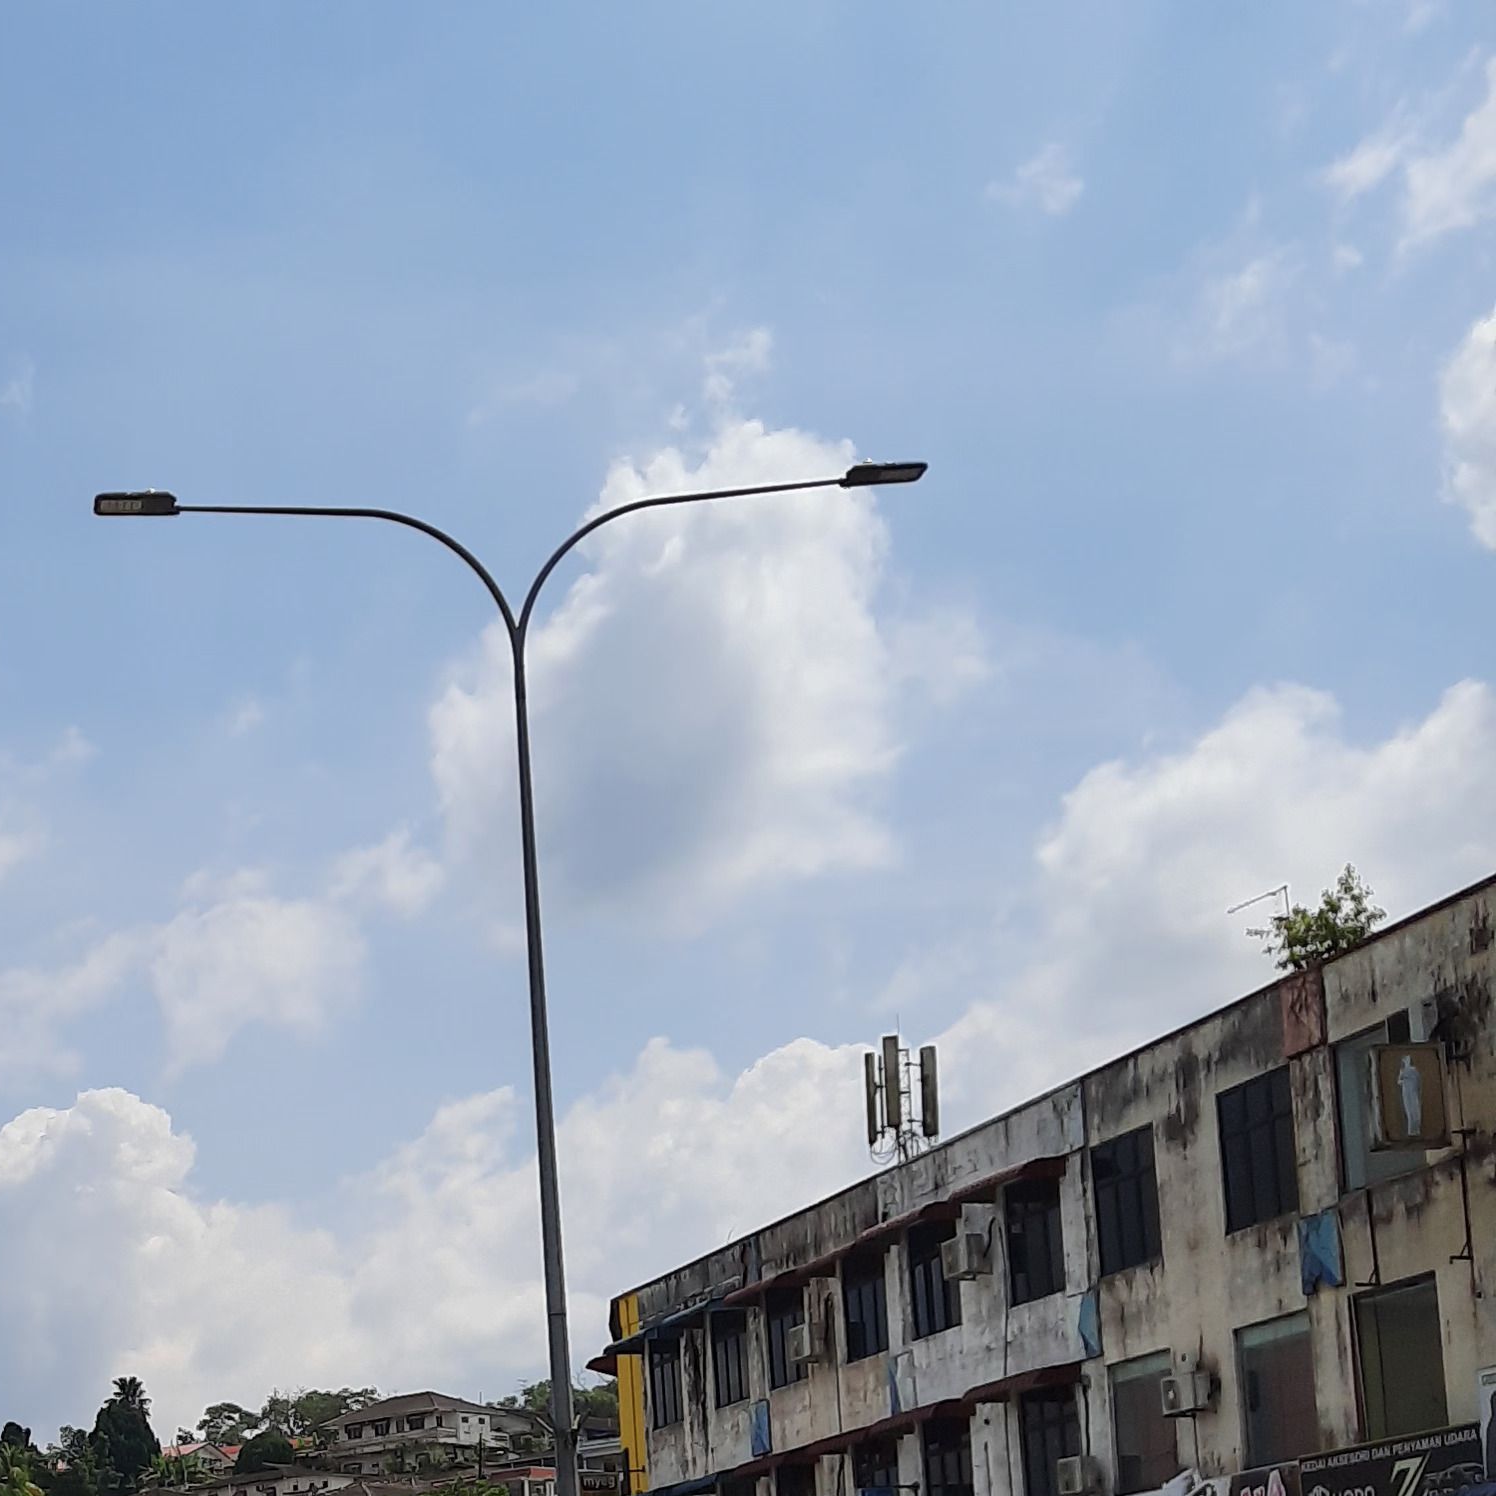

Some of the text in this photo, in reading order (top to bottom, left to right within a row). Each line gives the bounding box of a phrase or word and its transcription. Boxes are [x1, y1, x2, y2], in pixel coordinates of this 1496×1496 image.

[1371, 1446, 1391, 1460] DAN
[1392, 1436, 1442, 1456] PENYAMAN
[1443, 1429, 1477, 1446] UDARA
